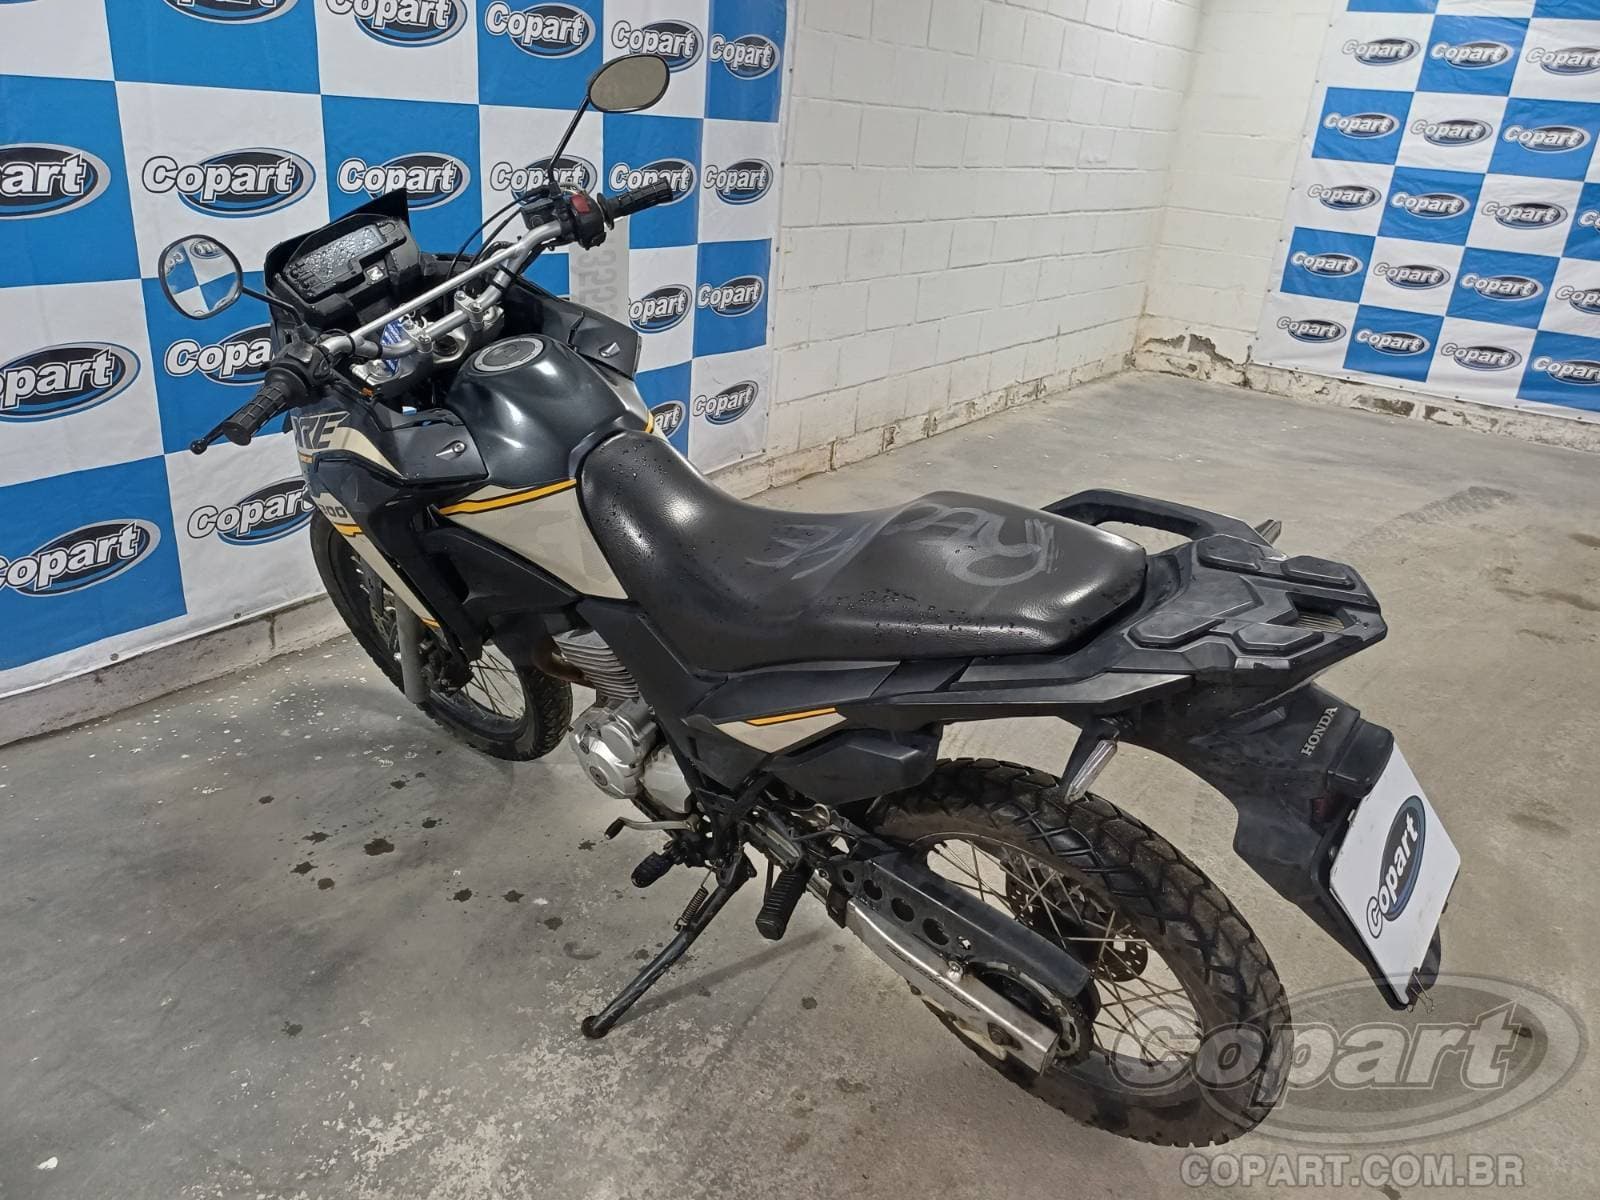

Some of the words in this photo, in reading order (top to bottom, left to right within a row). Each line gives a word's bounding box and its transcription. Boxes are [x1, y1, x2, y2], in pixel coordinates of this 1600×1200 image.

[484, 1, 586, 46] Copart
[611, 20, 696, 57] Copart
[1341, 39, 1413, 61] Copart
[709, 33, 773, 70] Copart
[1431, 43, 1503, 65] Copart
[1323, 112, 1392, 134] Copart
[1410, 119, 1482, 141] Copart
[1503, 125, 1584, 147] Copart
[0, 152, 86, 197] art
[142, 153, 295, 203] Copart
[337, 158, 456, 194] Copart
[703, 165, 768, 194] Copart
[1307, 184, 1373, 206] Copart
[1391, 192, 1463, 215] Copart
[1481, 201, 1557, 223] Copart
[1291, 252, 1358, 273] Copart
[1373, 263, 1441, 285] Copart
[697, 281, 760, 311] Copart
[1461, 274, 1536, 298] Copart
[1555, 286, 1600, 306] Cop
[628, 289, 687, 326] opart
[1277, 317, 1338, 339] Copart
[1356, 329, 1422, 351] Copart
[164, 338, 274, 378] Copa
[1441, 343, 1512, 366] Copart
[0, 347, 115, 409] part
[1532, 357, 1600, 379] Copar
[693, 384, 754, 417] Copart
[654, 405, 681, 430] art
[0, 522, 141, 592] opart
[1300, 706, 1338, 756] HONDA
[1366, 813, 1419, 939] Copart
